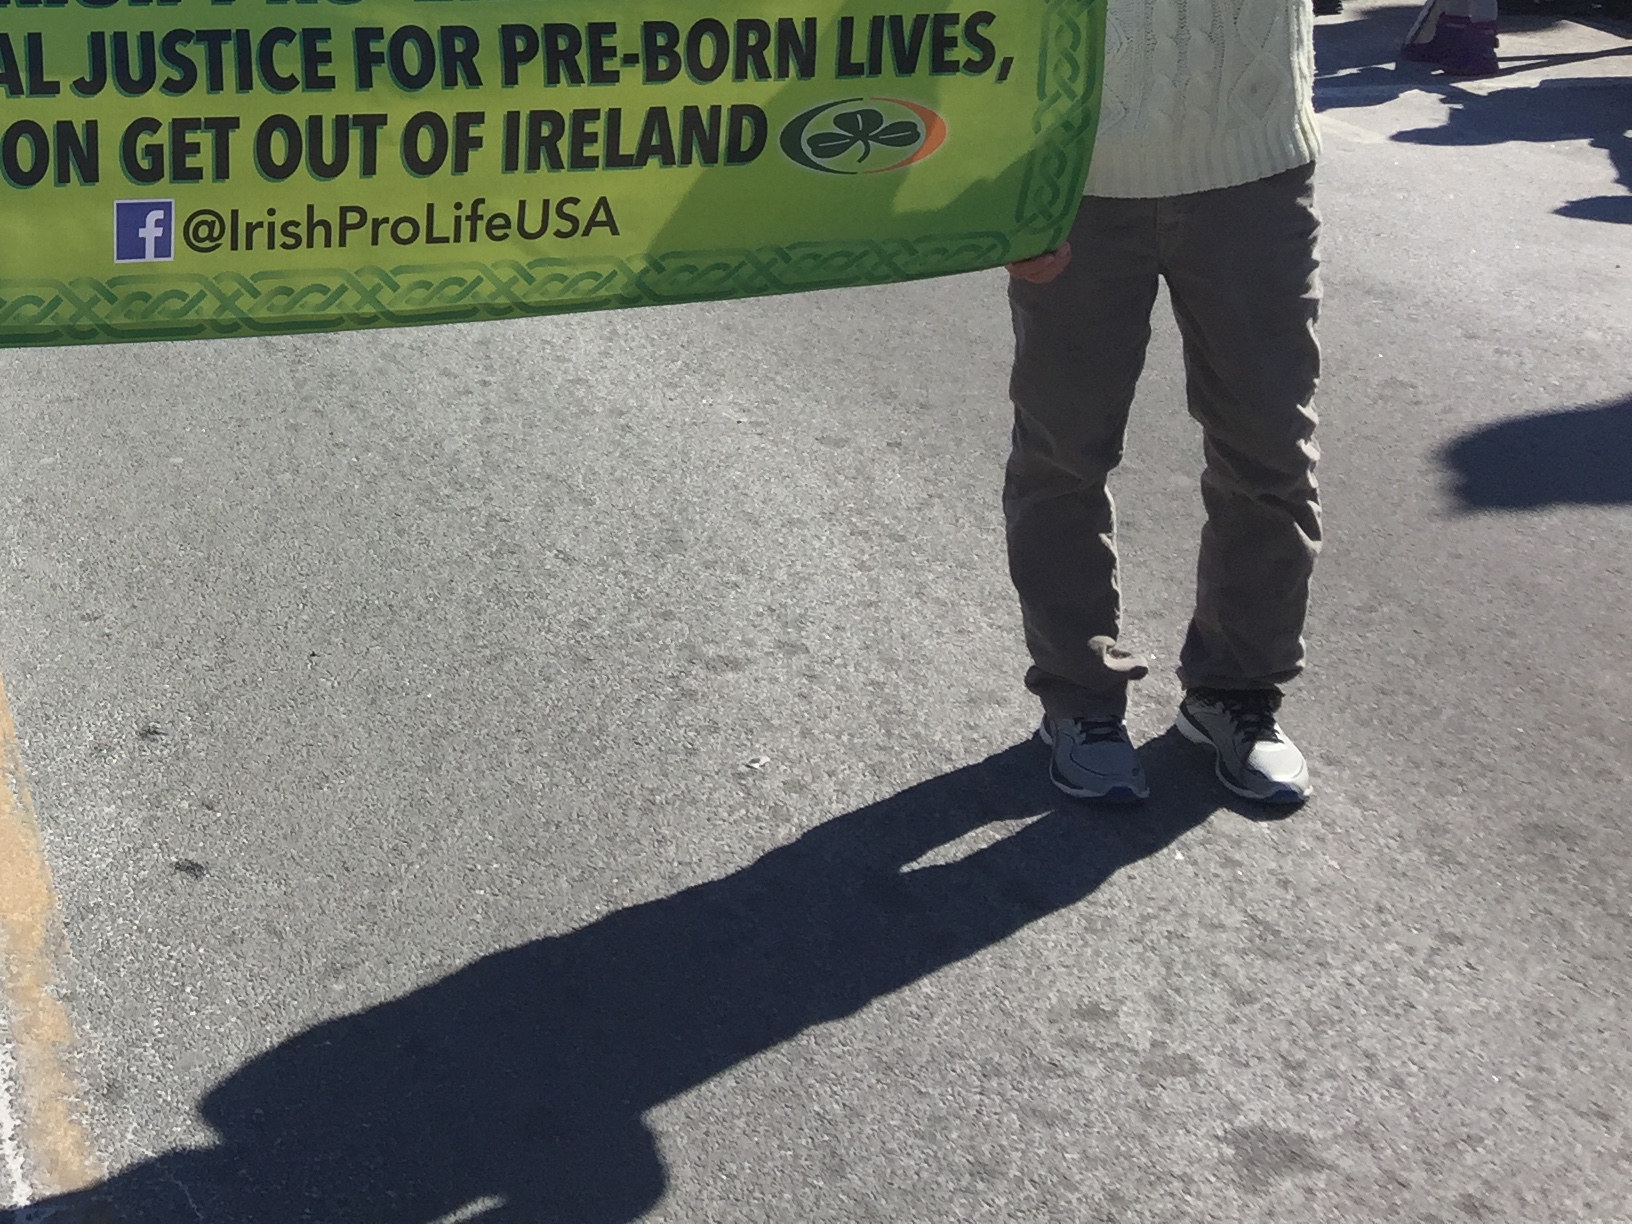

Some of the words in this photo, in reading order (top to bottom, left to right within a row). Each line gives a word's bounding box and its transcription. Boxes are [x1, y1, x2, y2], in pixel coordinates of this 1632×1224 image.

[72, 26, 335, 96] JUSTICE
[353, 24, 483, 93] FOR
[498, 16, 816, 86] PRE-BORN
[835, 10, 1014, 82] LIVES,
[121, 116, 240, 184] GET
[255, 113, 387, 180] OUT
[402, 110, 485, 176] OF
[504, 103, 768, 172] IRELAND
[182, 195, 620, 254] @IrishProLifeUSA
